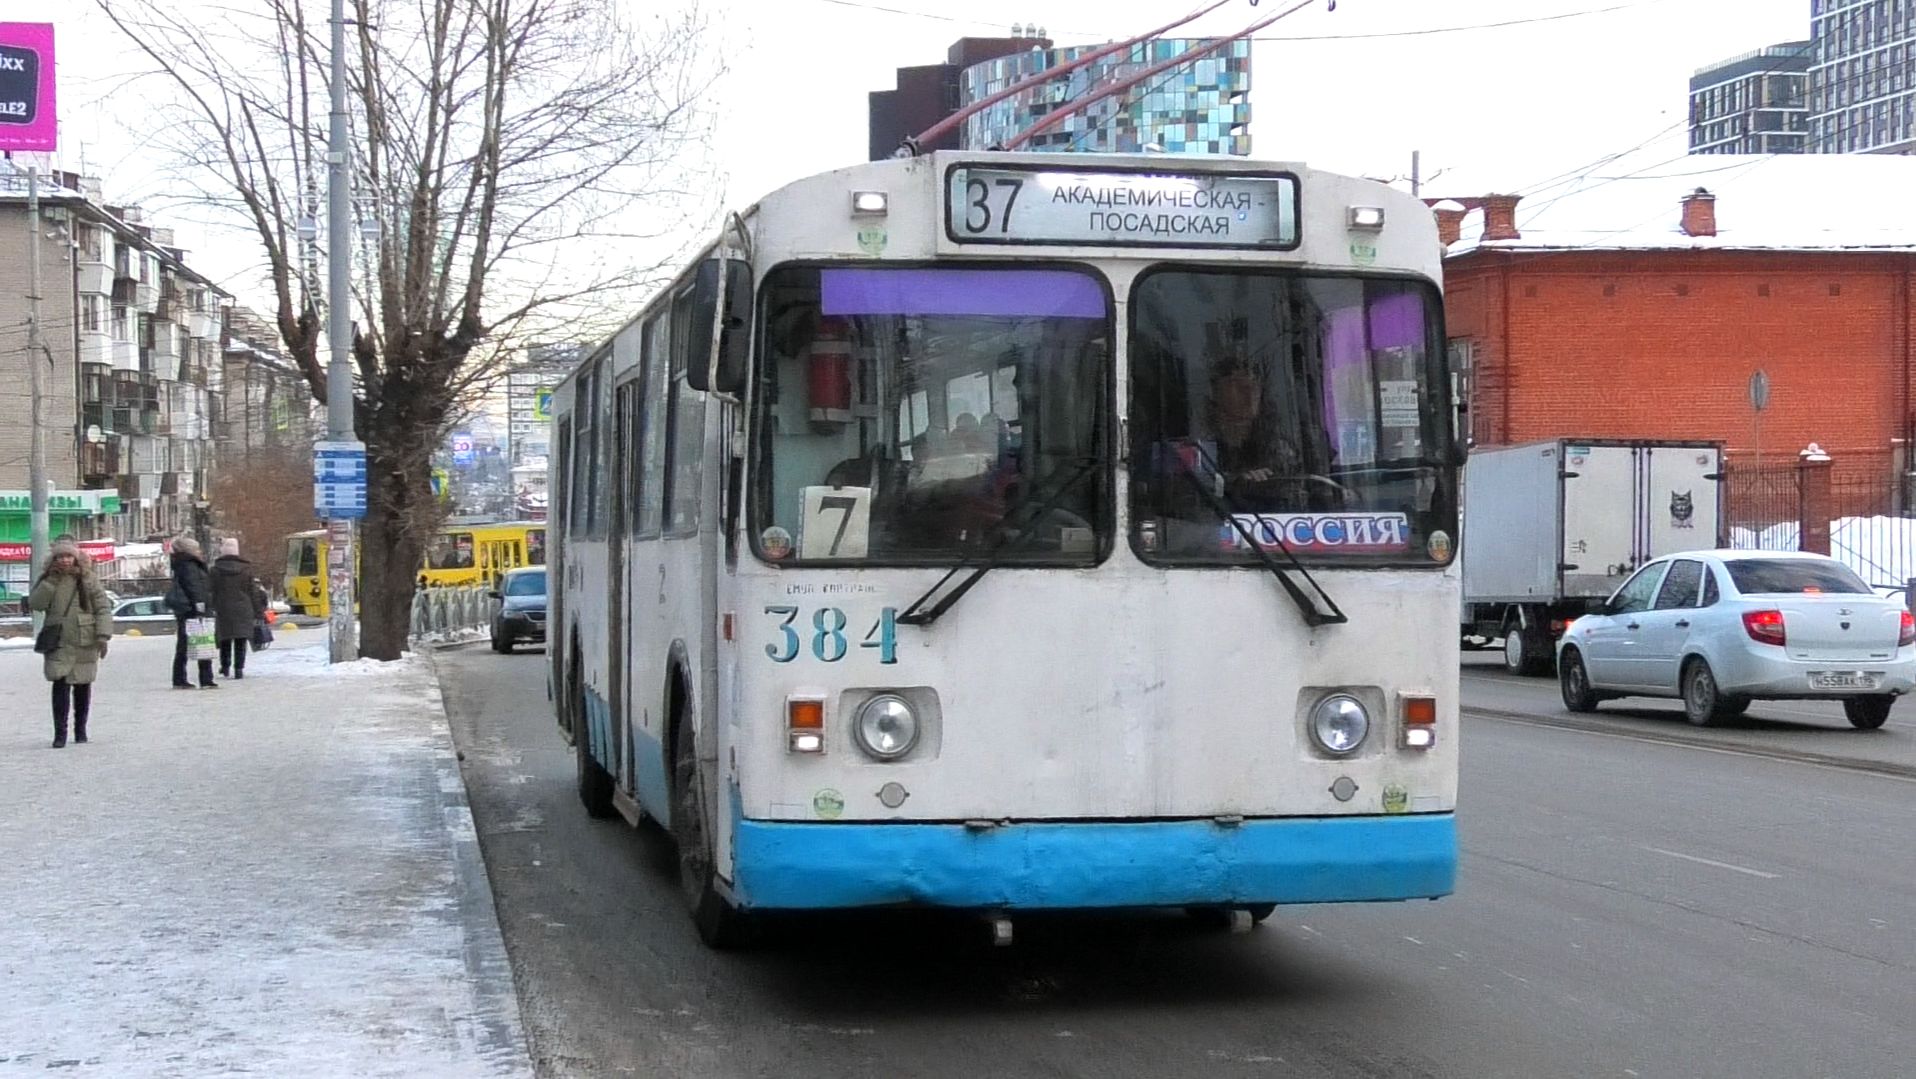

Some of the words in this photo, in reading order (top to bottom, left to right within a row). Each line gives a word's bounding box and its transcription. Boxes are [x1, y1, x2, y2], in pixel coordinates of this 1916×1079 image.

[966, 178, 1023, 233] 37
[1052, 185, 1251, 210] АКАДЕМИЧЕСКАЯ
[1089, 211, 1229, 235] ПОСАДСКАЯ
[818, 496, 857, 556] 7
[1225, 516, 1406, 546] РОССИЯ
[764, 605, 898, 664] 384
